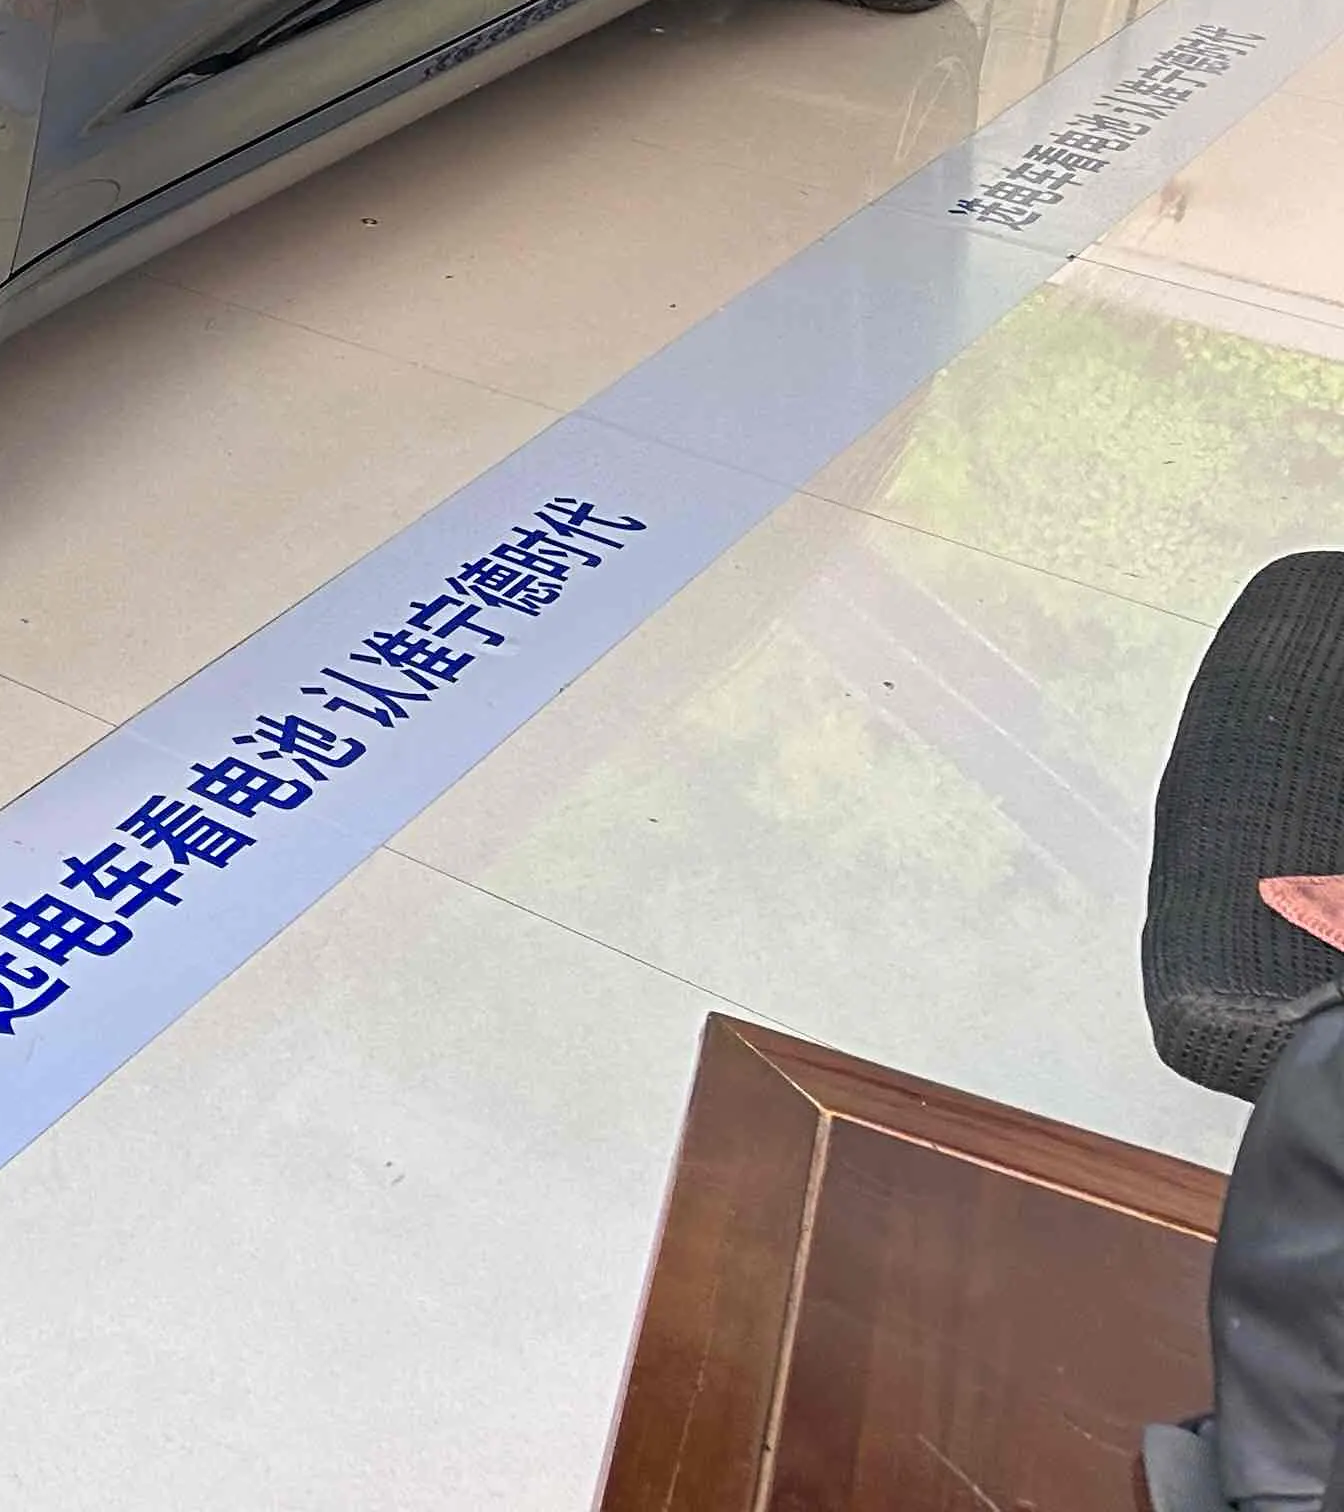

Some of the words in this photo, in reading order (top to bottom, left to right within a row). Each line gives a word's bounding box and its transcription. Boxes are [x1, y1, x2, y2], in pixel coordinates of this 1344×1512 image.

[948, 112, 1151, 232] 选电车看电池
[1095, 23, 1267, 120] 认准宁德时代
[299, 496, 648, 730] 认准宁德时代
